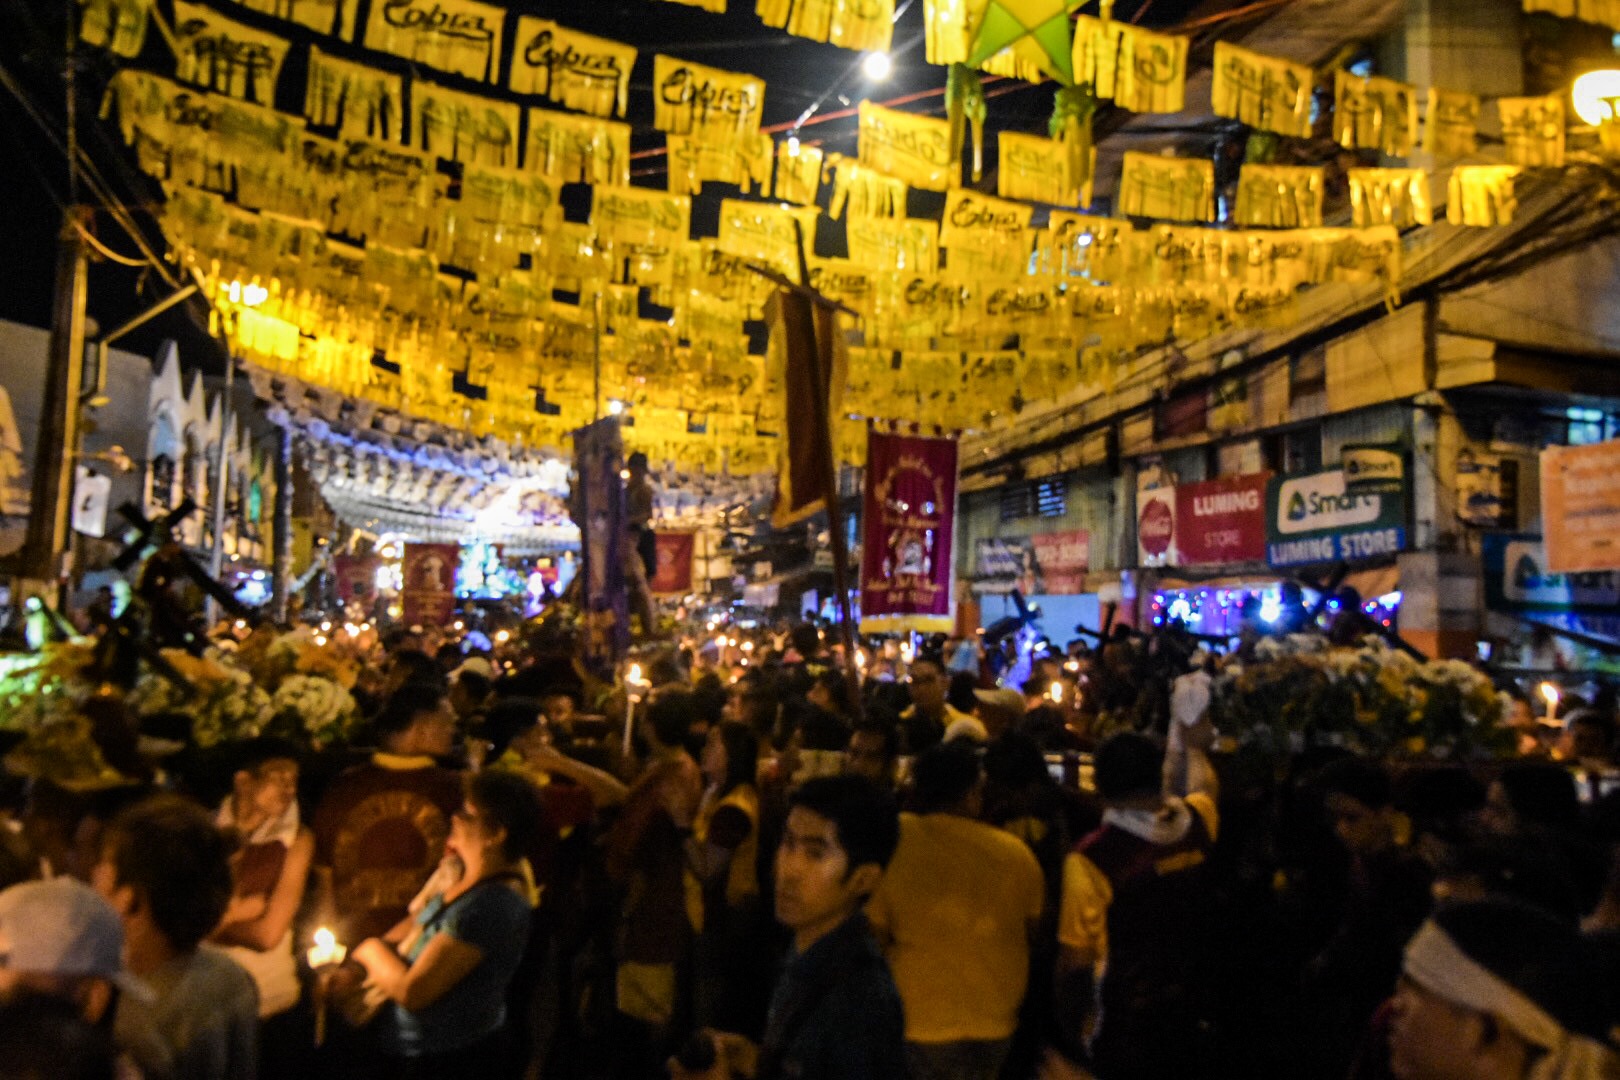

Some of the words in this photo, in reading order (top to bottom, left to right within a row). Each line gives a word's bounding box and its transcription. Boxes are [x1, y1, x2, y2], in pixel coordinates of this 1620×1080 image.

[384, 0, 492, 40] Cobra
[524, 30, 622, 79] Cobra
[661, 67, 756, 115] Cobra
[1193, 489, 1259, 516] LUMING
[1270, 536, 1334, 564] LUMING
[1340, 528, 1397, 558] STORE
